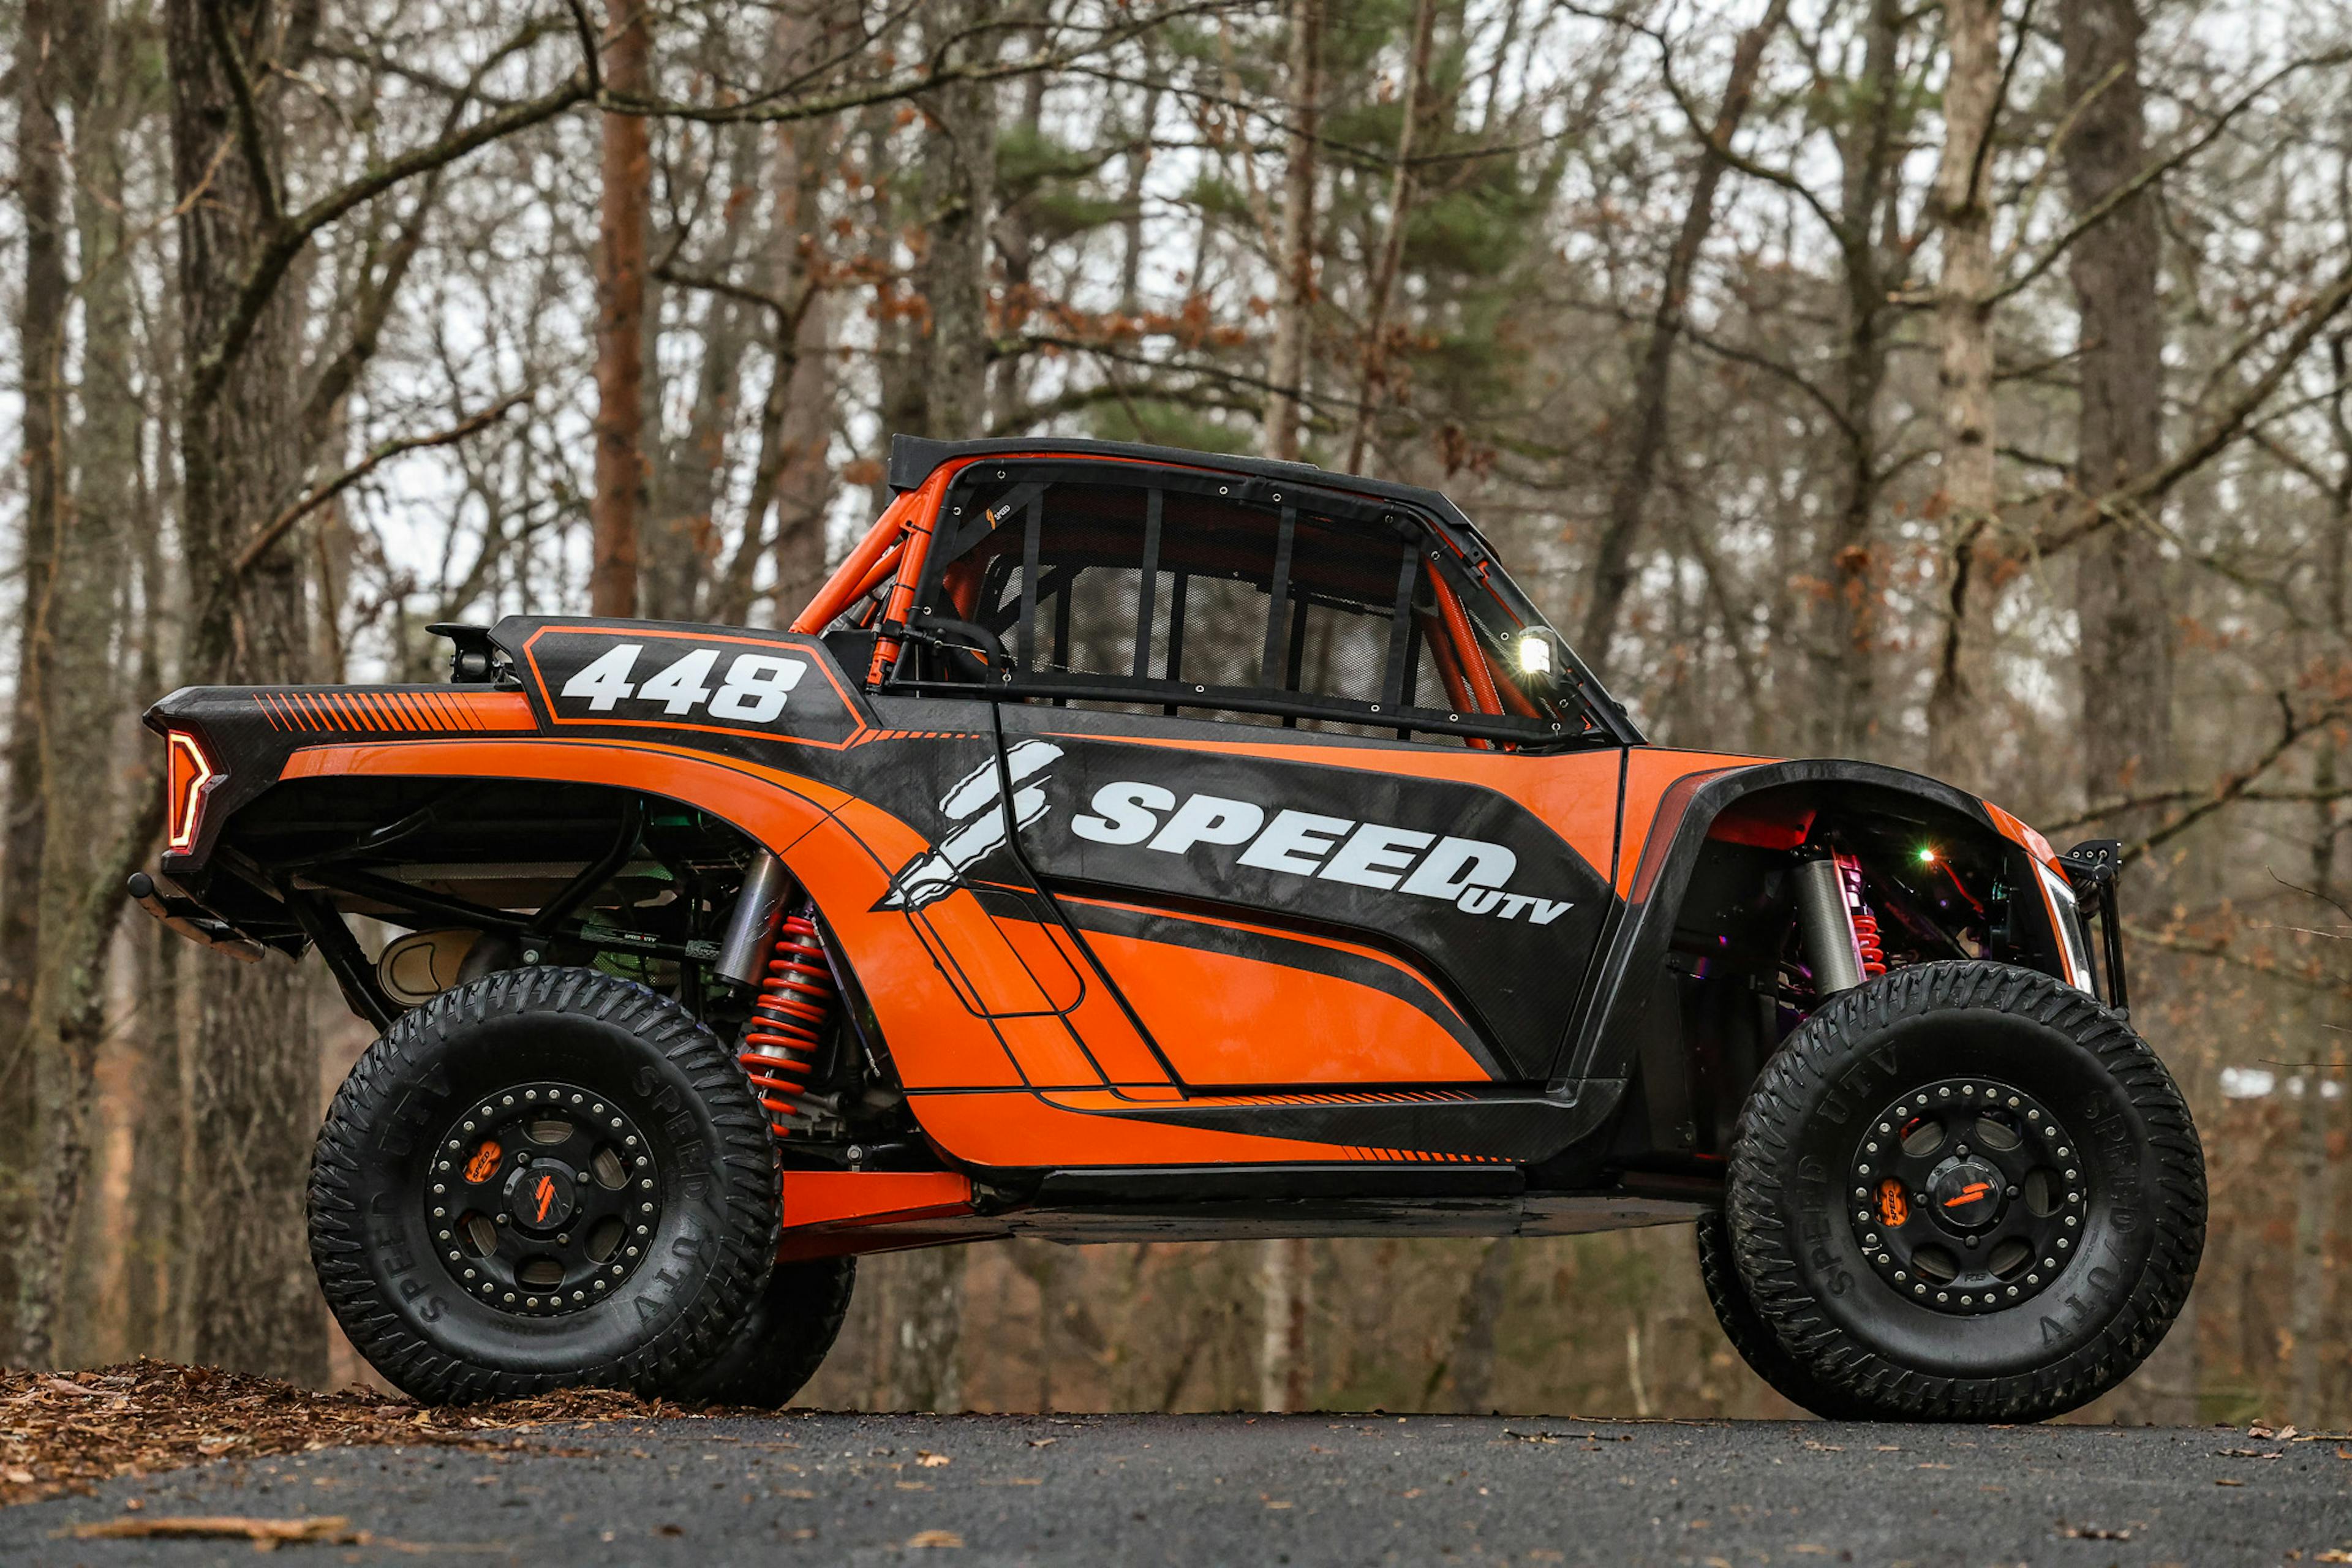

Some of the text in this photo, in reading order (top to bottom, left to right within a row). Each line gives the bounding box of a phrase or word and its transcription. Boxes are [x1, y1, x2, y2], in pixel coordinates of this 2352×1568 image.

[560, 644, 807, 723] 448
[1071, 781, 1575, 925] SPEED UTV
[369, 1063, 451, 1324] SPEED UTV
[472, 1151, 490, 1178] SPEED
[631, 1067, 709, 1325] SPEED UTV
[1798, 1041, 1899, 1298] SPEED UTV
[1888, 1190, 1898, 1221] SPEED
[2086, 1091, 2139, 1234] SPEED
[2038, 1265, 2117, 1348] UTV
